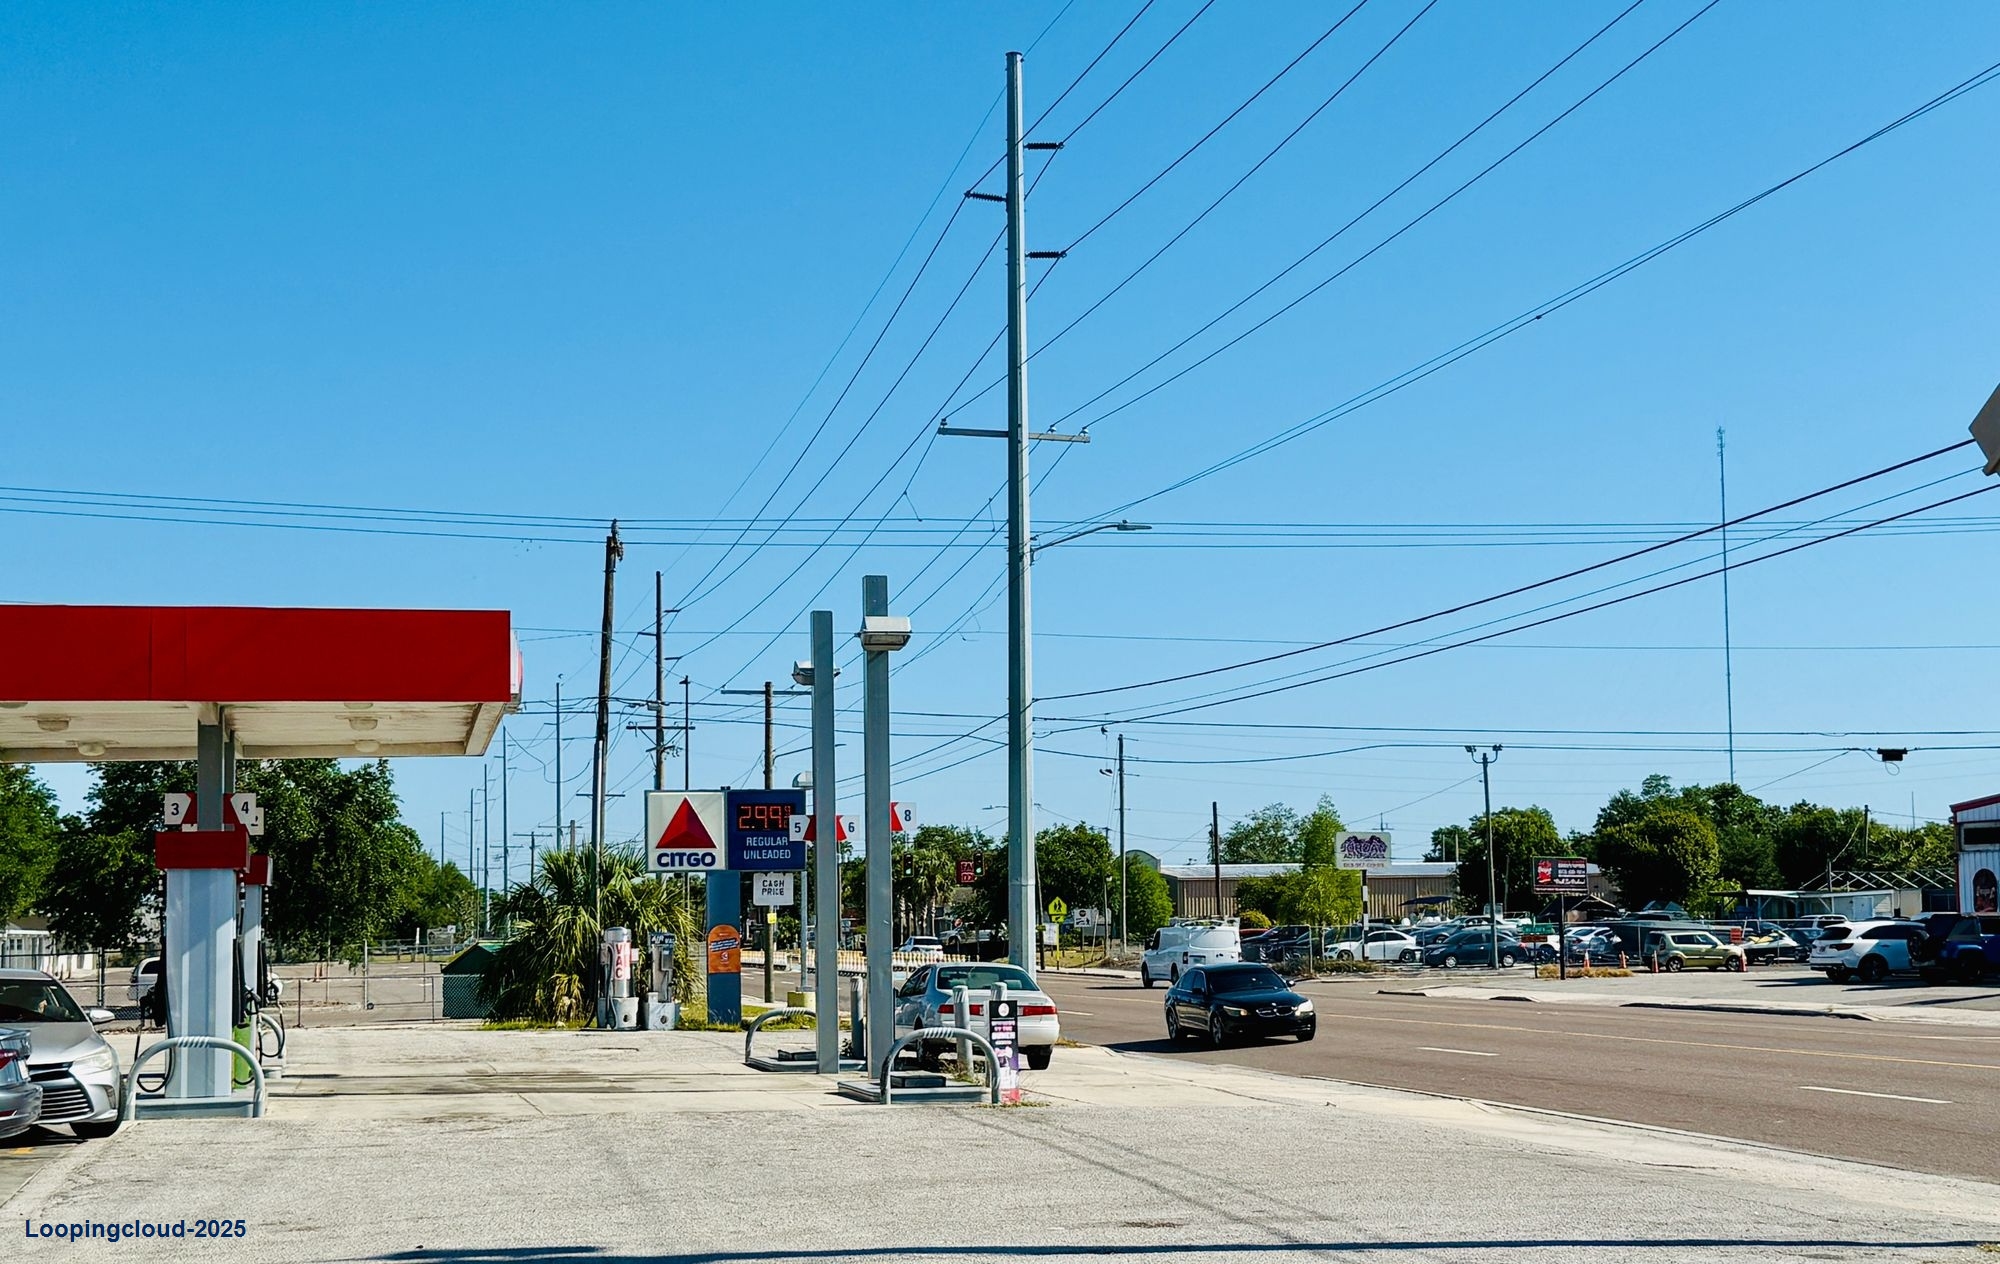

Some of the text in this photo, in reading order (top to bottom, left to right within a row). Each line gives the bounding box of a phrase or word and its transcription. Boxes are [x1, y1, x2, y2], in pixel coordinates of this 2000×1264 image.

[171, 803, 179, 815] 3
[241, 801, 249, 814] 4
[904, 809, 911, 821] 8
[794, 822, 801, 833] 5
[848, 822, 855, 833] 6
[746, 837, 788, 846] REGULAR
[657, 852, 716, 868] CITGO
[743, 849, 791, 860] UNLEADED
[762, 880, 784, 888] CASH
